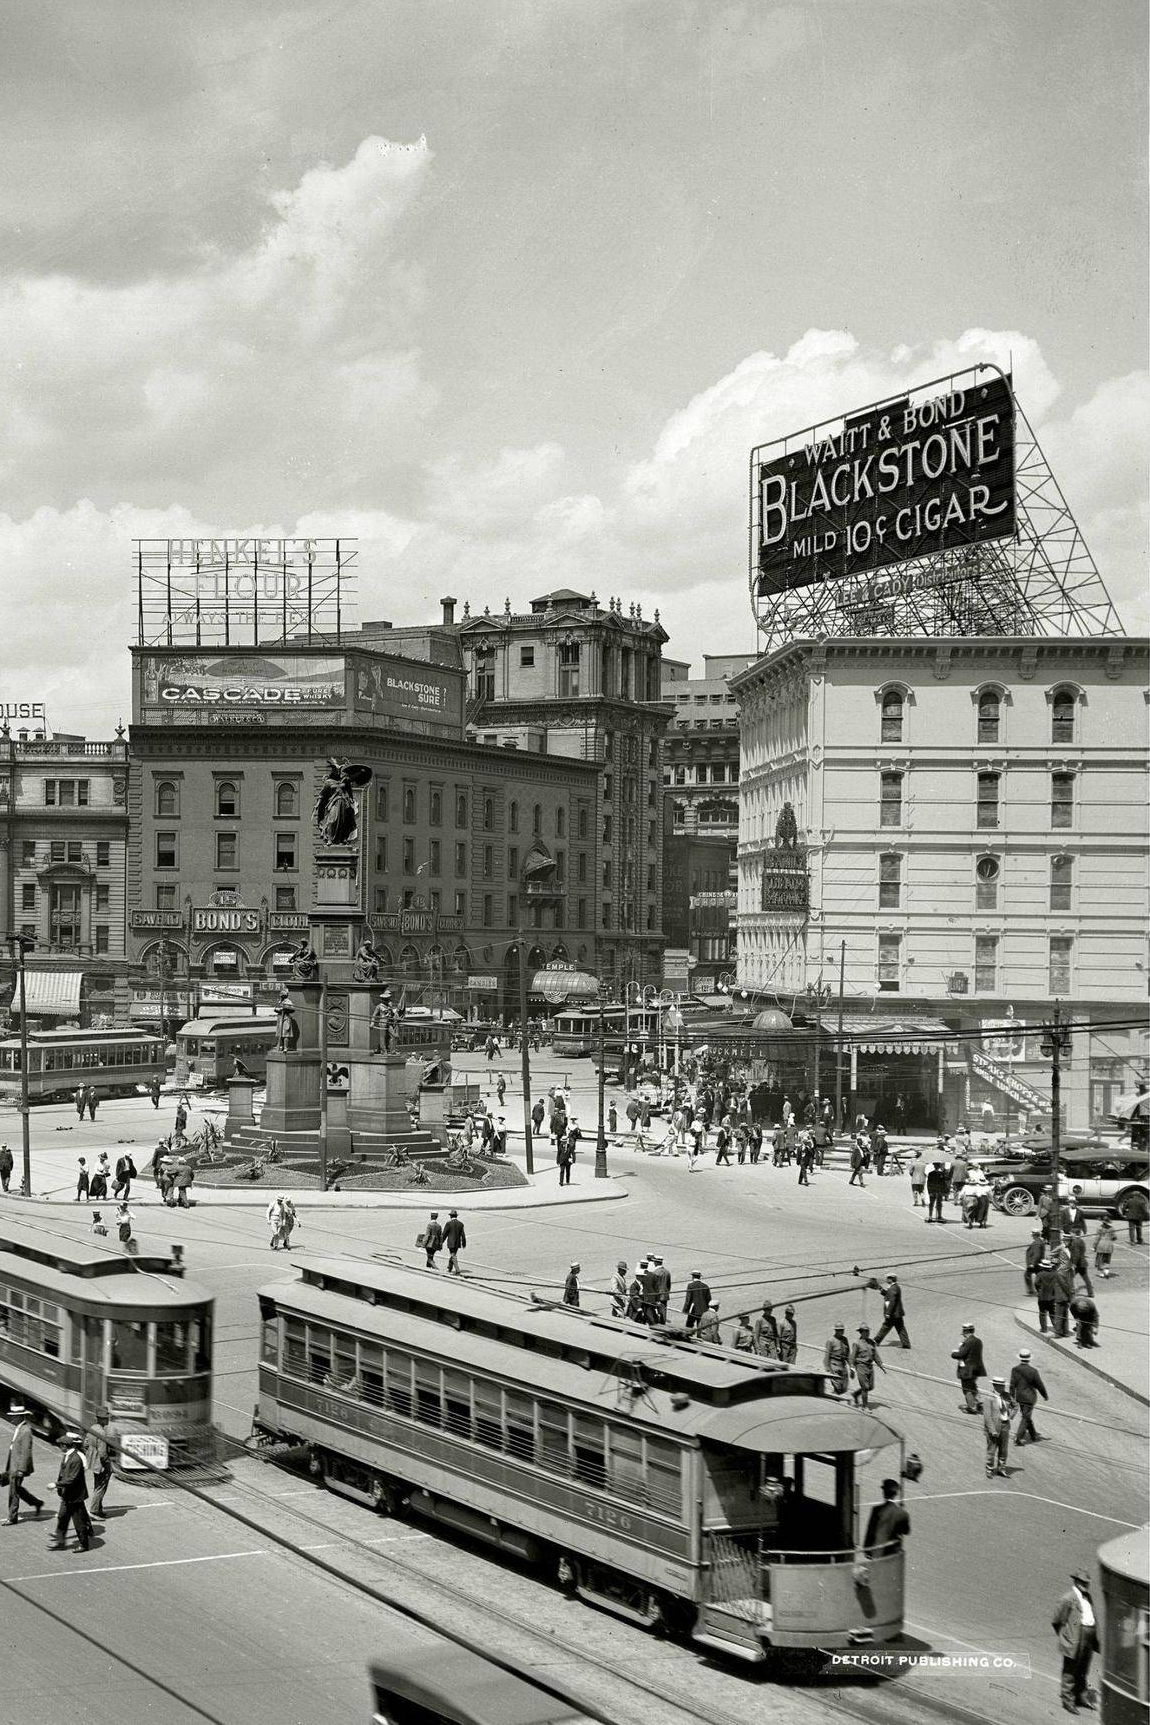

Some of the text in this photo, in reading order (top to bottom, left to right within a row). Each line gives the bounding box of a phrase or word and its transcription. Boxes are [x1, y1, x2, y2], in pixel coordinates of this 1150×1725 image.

[804, 390, 965, 467] WAITT & BOND
[760, 415, 1000, 547] BLACKSTONE
[793, 531, 837, 559] MILD
[895, 485, 1008, 541] CIGAR
[169, 539, 317, 564] HENKEL'S
[197, 574, 302, 599] FLOUR
[162, 688, 301, 700] CASCADE
[387, 678, 440, 695] BLACKSTONE
[417, 694, 440, 705] SURE
[196, 912, 257, 930] BOND'S
[404, 914, 433, 931] BOND'S
[585, 1502, 631, 1529] 7126
